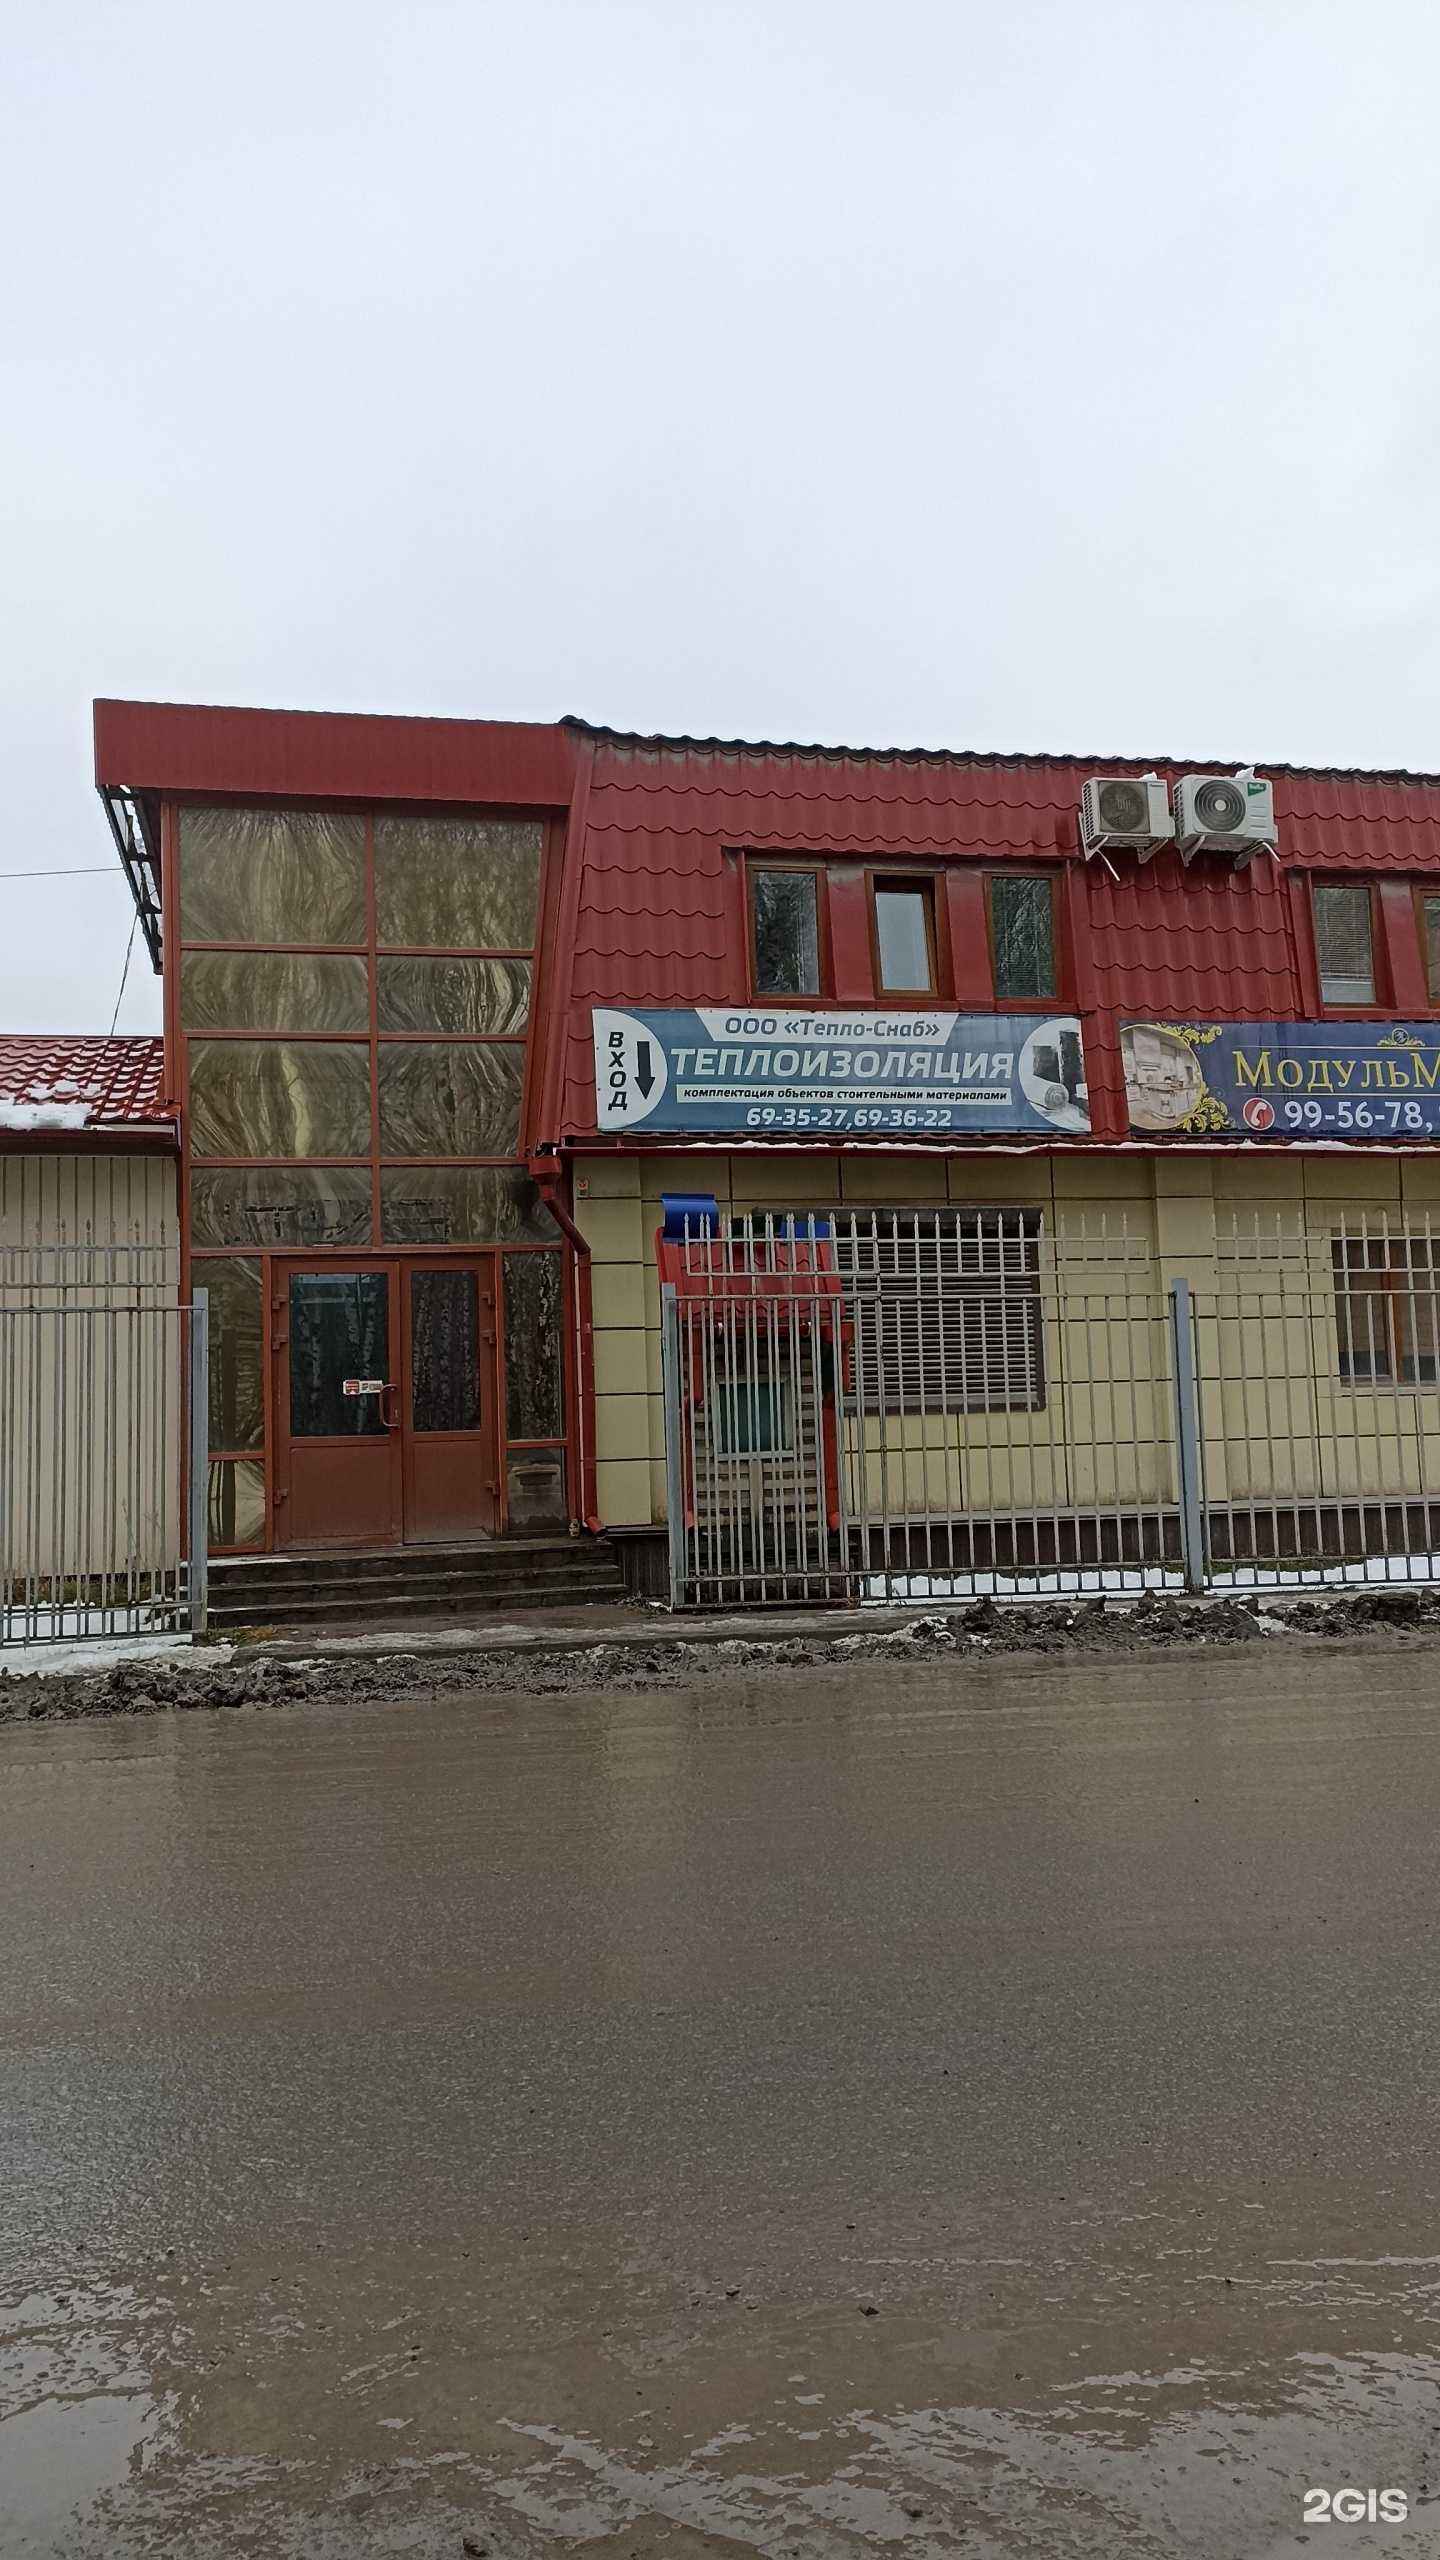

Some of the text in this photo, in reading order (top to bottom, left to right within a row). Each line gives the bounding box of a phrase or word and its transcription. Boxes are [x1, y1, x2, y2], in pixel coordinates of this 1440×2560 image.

[725, 1016, 941, 1037] ООО «Тепло-Снаб»
[607, 1031, 628, 1111] ВХОД
[670, 1048, 1015, 1084] ТЕПЛОИЗОЛЯЦИЯ
[684, 1087, 1008, 1102] комплектация объектов стоительными материалами
